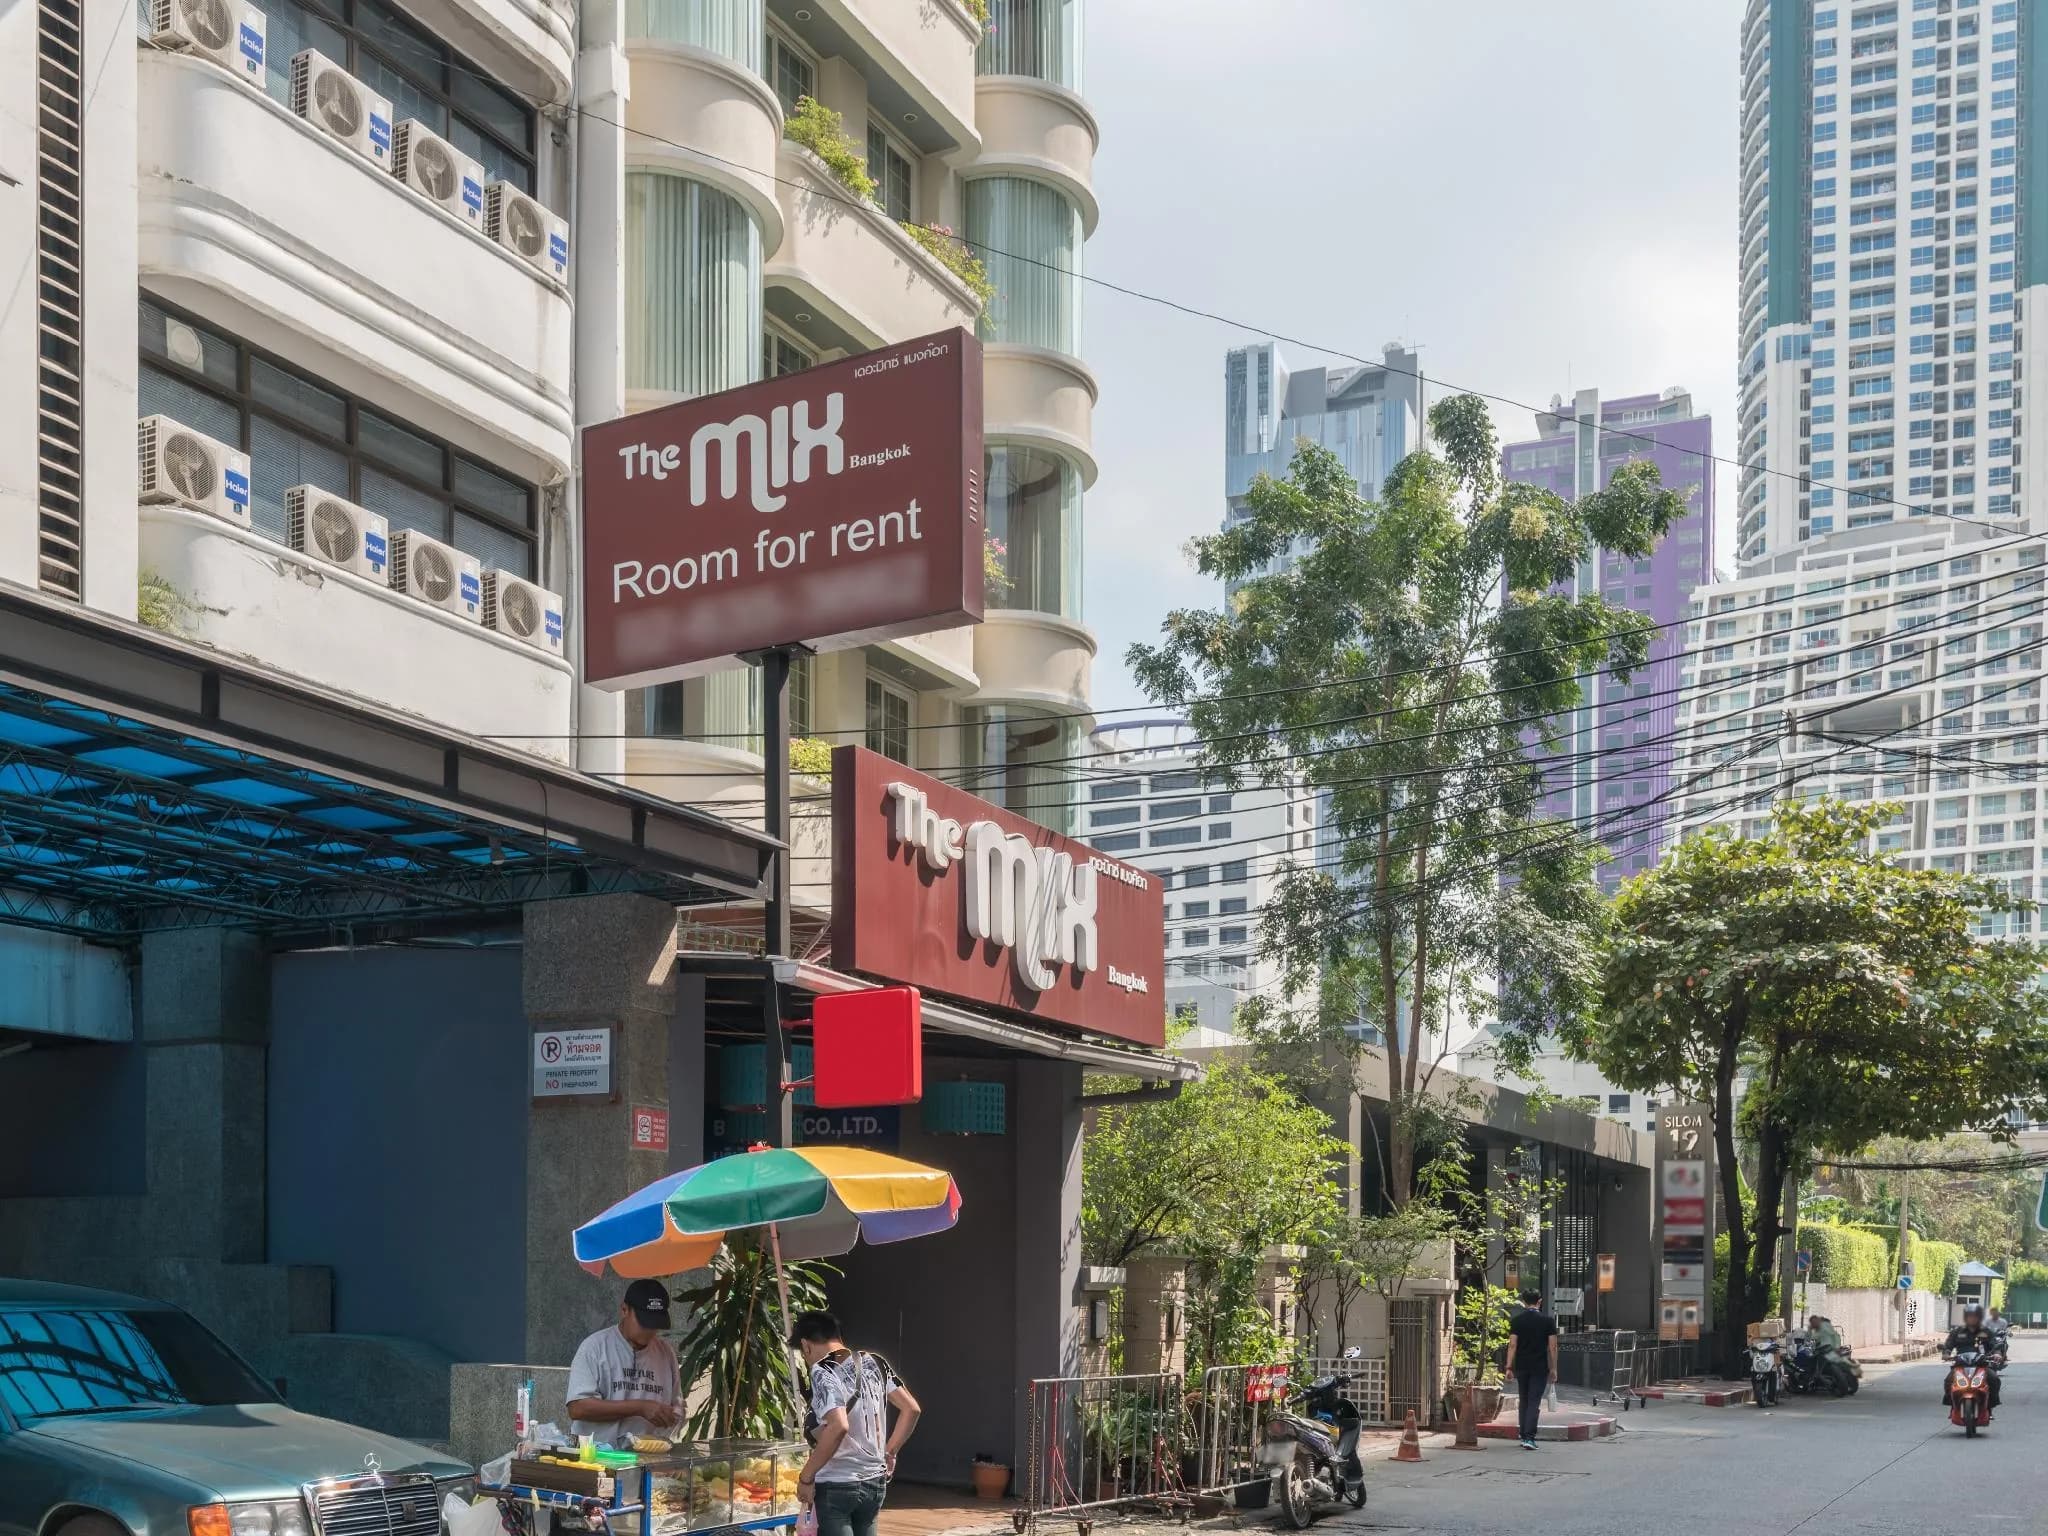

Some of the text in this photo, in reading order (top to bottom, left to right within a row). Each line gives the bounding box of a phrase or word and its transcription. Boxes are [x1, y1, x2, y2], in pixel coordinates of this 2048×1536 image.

[240, 33, 263, 54] Haier
[370, 121, 390, 141] Haier
[618, 442, 680, 480] The
[849, 443, 911, 469] Bangkok
[225, 478, 248, 496] Haier
[366, 541, 385, 557] Haier
[613, 548, 738, 603] Room
[754, 529, 815, 572] for
[831, 498, 922, 557] rent
[888, 781, 964, 869] The
[1107, 965, 1147, 992] Bangkok
[546, 1080, 559, 1088] NO
[1665, 1115, 1702, 1128] SILOM
[1670, 1129, 1698, 1151] 19
